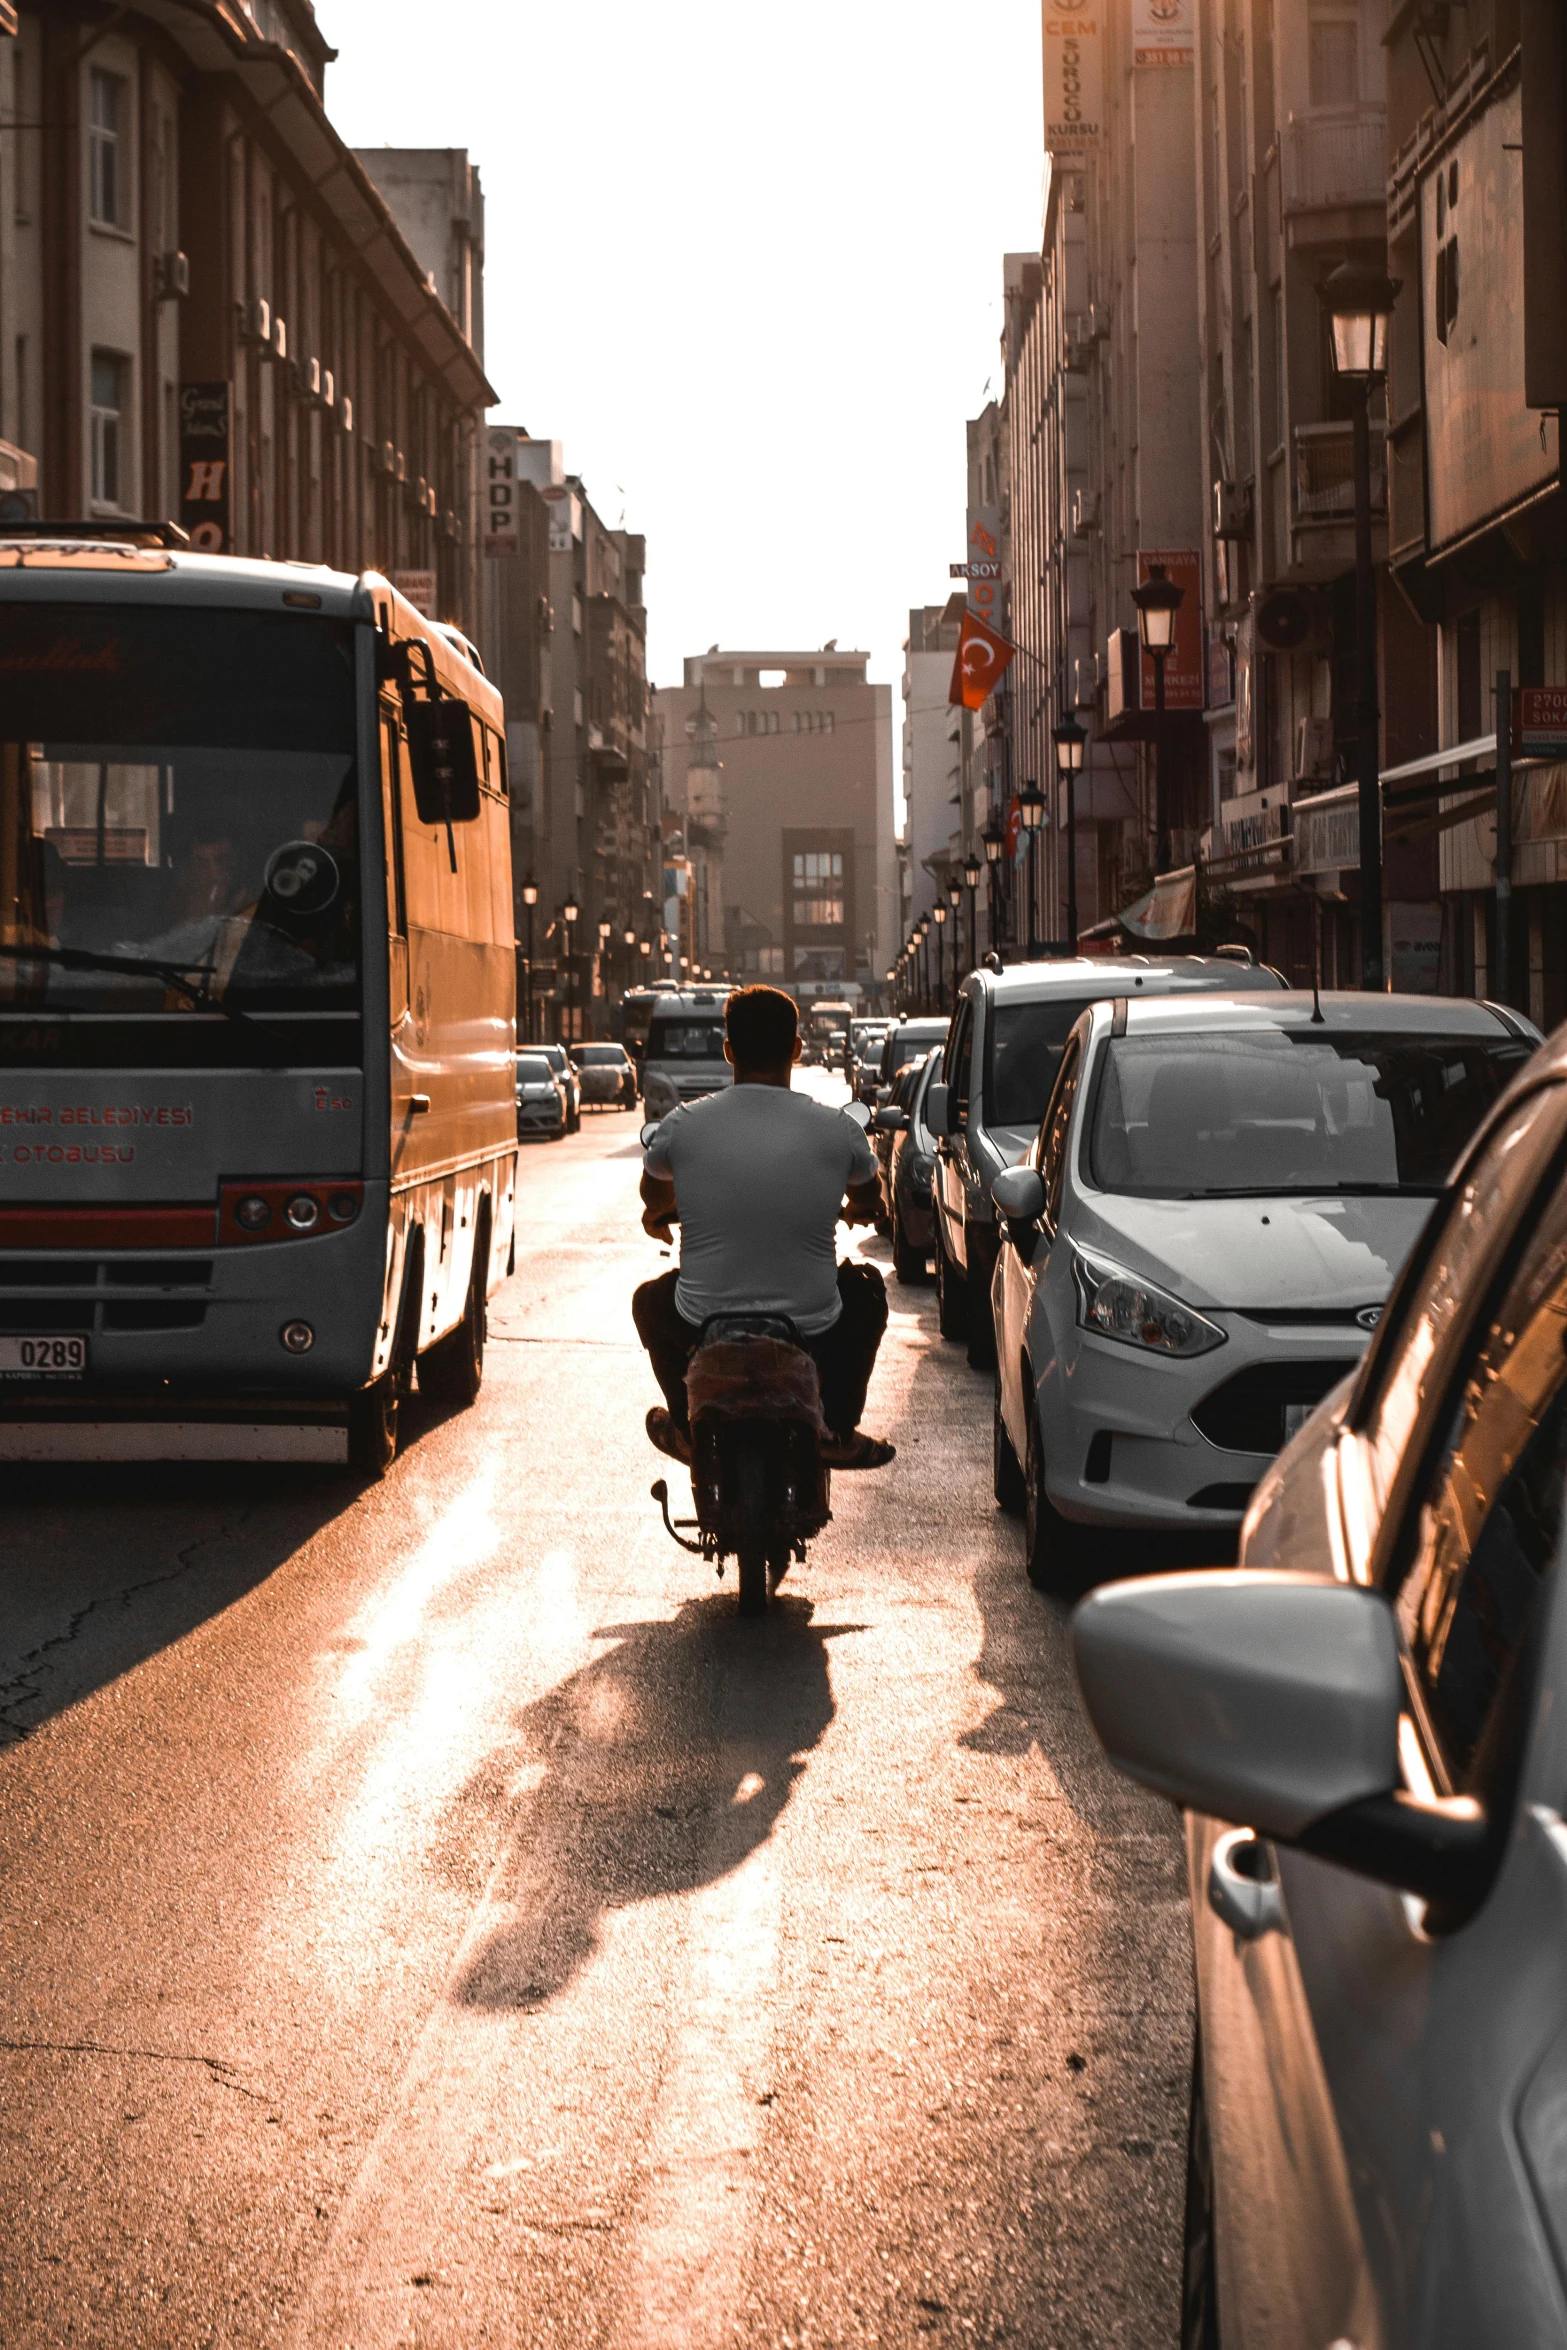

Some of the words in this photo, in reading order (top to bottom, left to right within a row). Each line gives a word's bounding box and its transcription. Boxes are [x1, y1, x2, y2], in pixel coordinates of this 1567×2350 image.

[1046, 21, 1097, 36] CEM
[1048, 124, 1099, 136] KURSU
[952, 563, 999, 577] AKSOY
[1145, 673, 1199, 687] MRKEZİ
[21, 1341, 82, 1368] 0289
